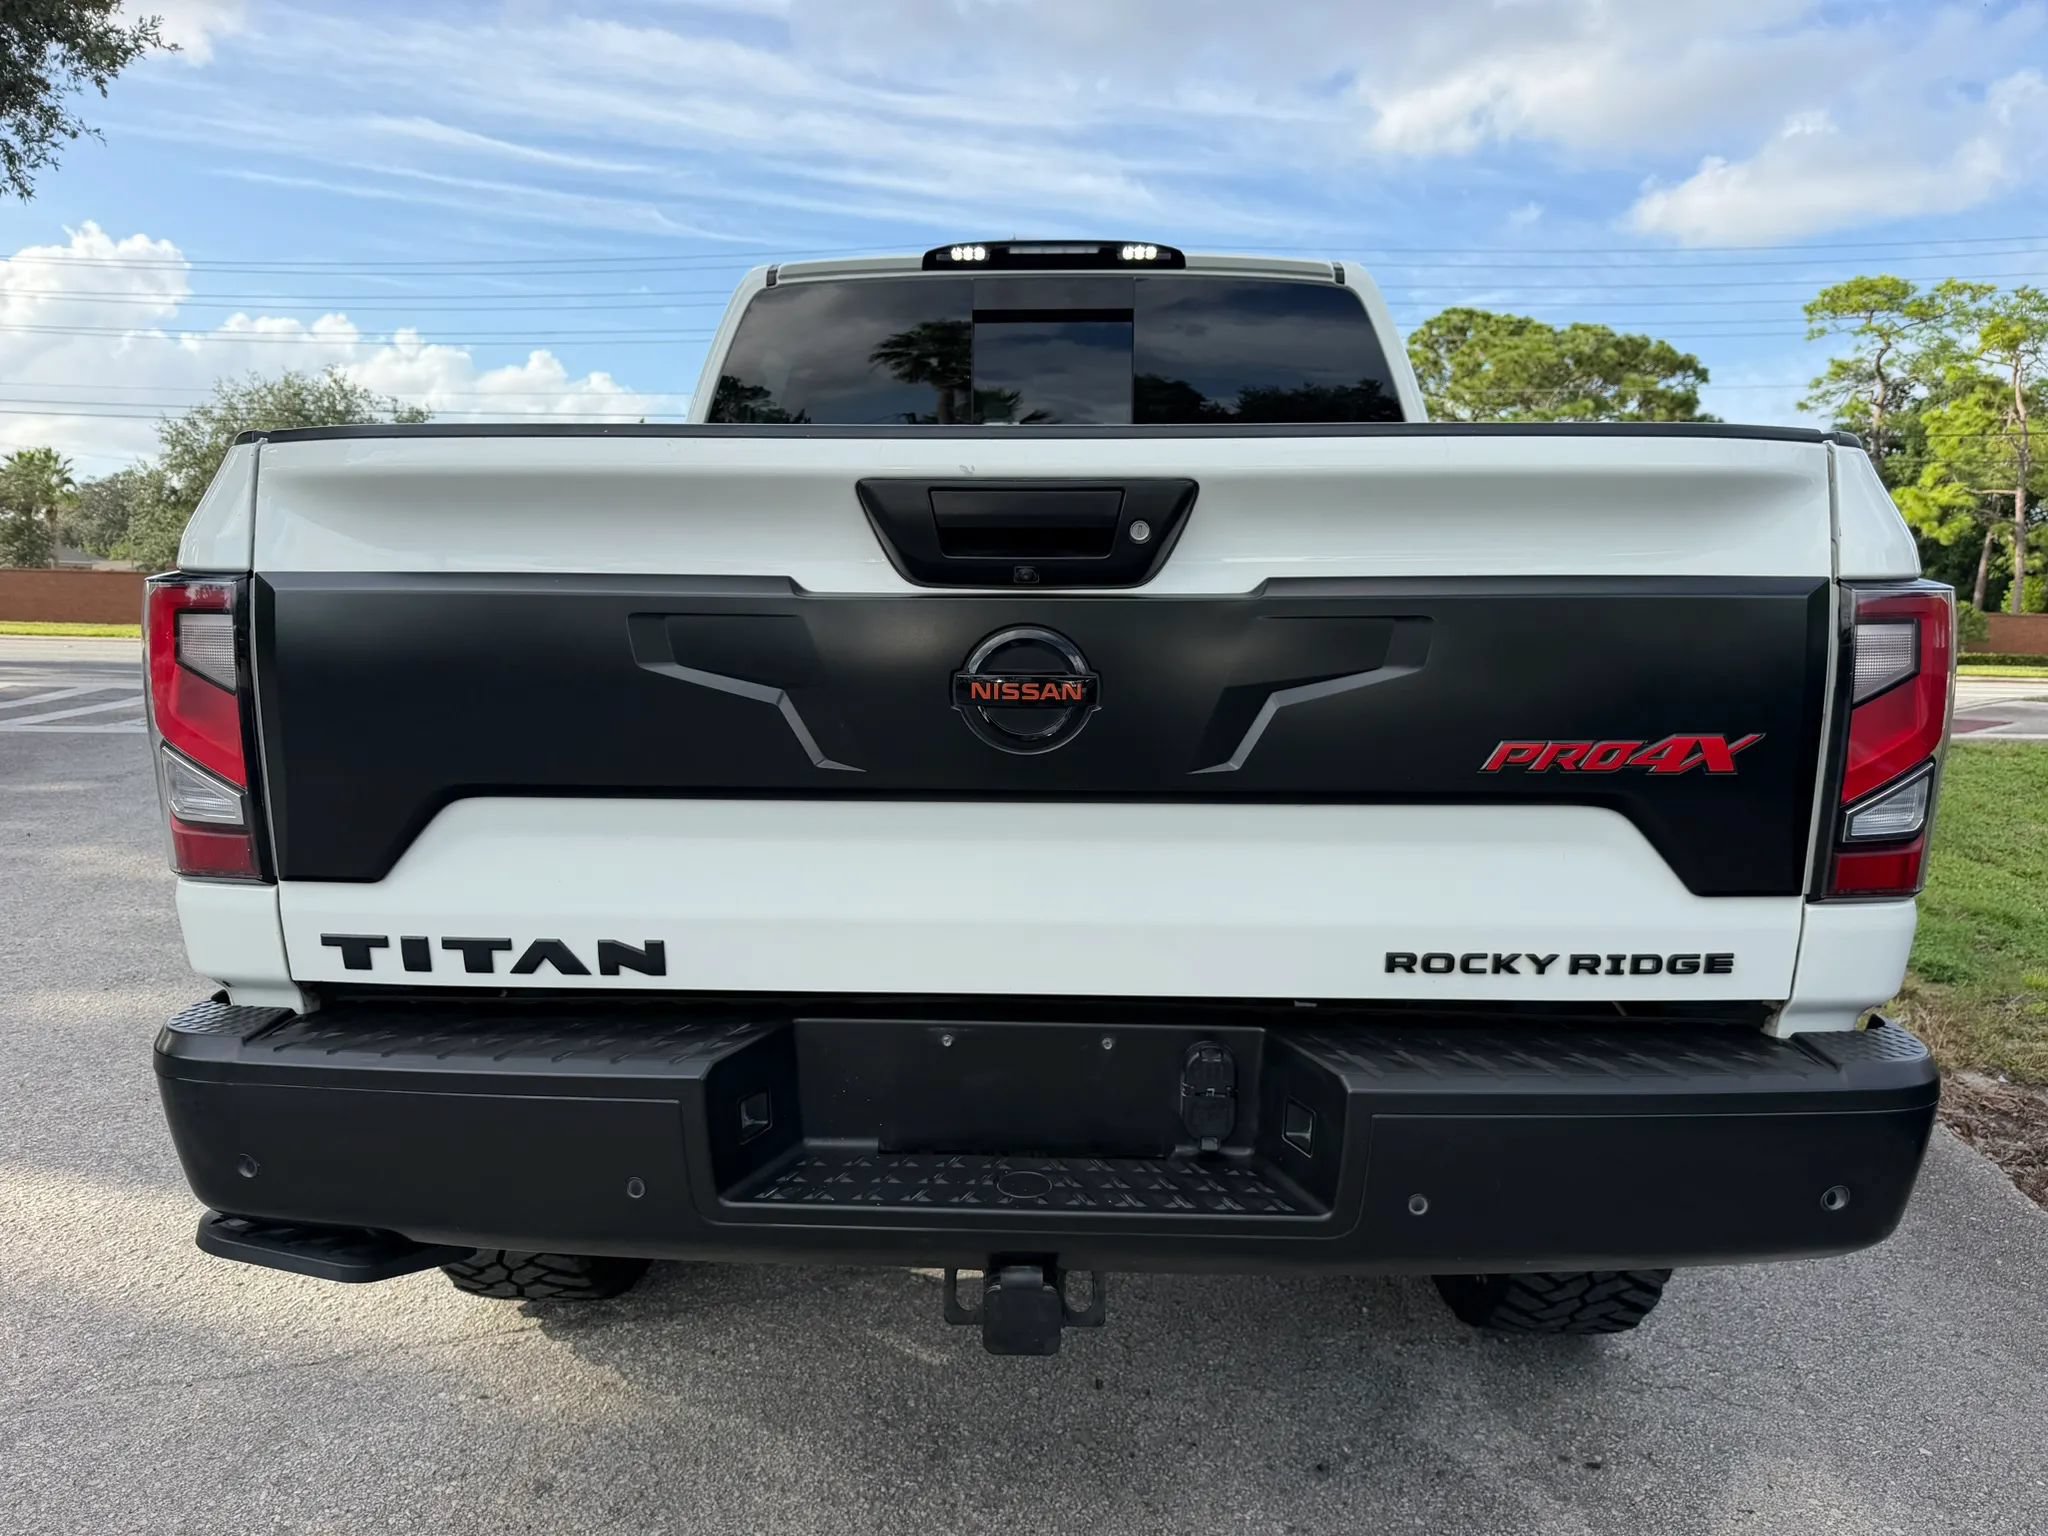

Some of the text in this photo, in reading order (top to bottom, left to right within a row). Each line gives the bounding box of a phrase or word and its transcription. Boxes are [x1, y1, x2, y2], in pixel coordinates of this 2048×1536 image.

[970, 682, 1083, 701] NISSAN
[1480, 733, 1765, 775] PRO4X
[320, 933, 667, 976] TITAN
[1384, 951, 1735, 976] ROCKY RIDGE
